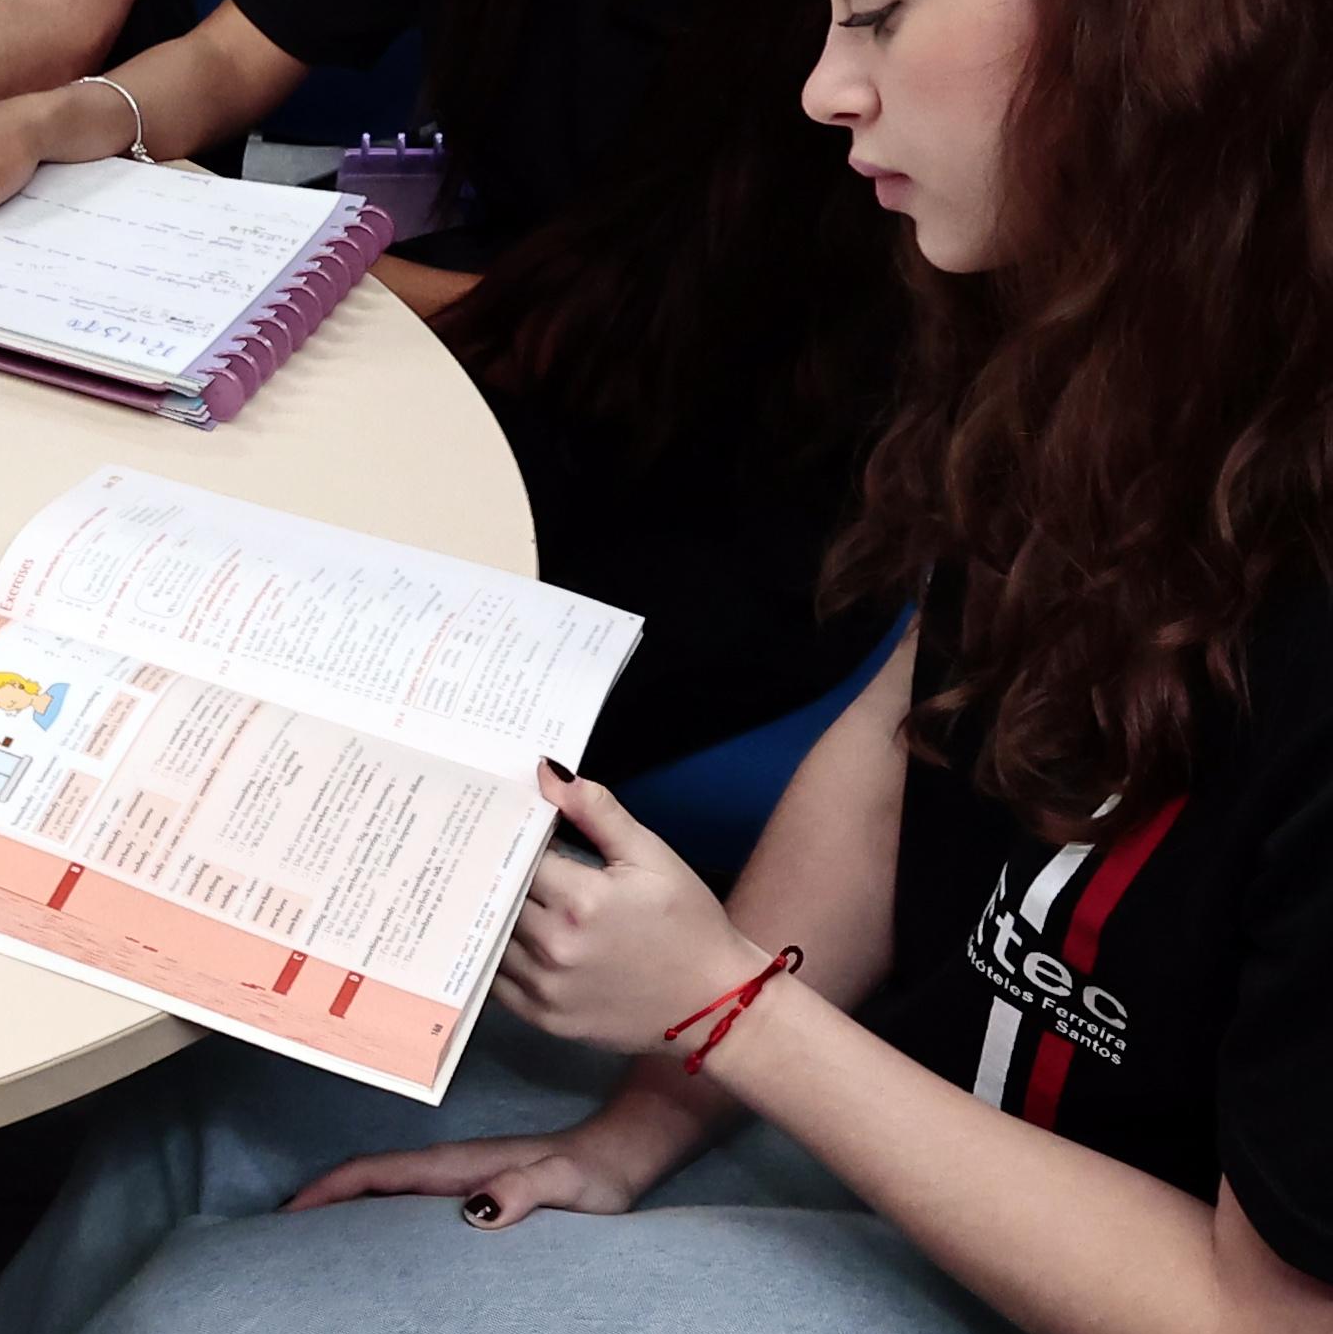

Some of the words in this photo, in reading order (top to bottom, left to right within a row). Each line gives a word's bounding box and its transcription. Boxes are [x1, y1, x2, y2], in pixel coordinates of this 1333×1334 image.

[0, 557, 35, 612] Exercises
[1042, 996, 1127, 1051] Ferreira
[1055, 1020, 1122, 1065] Santos
